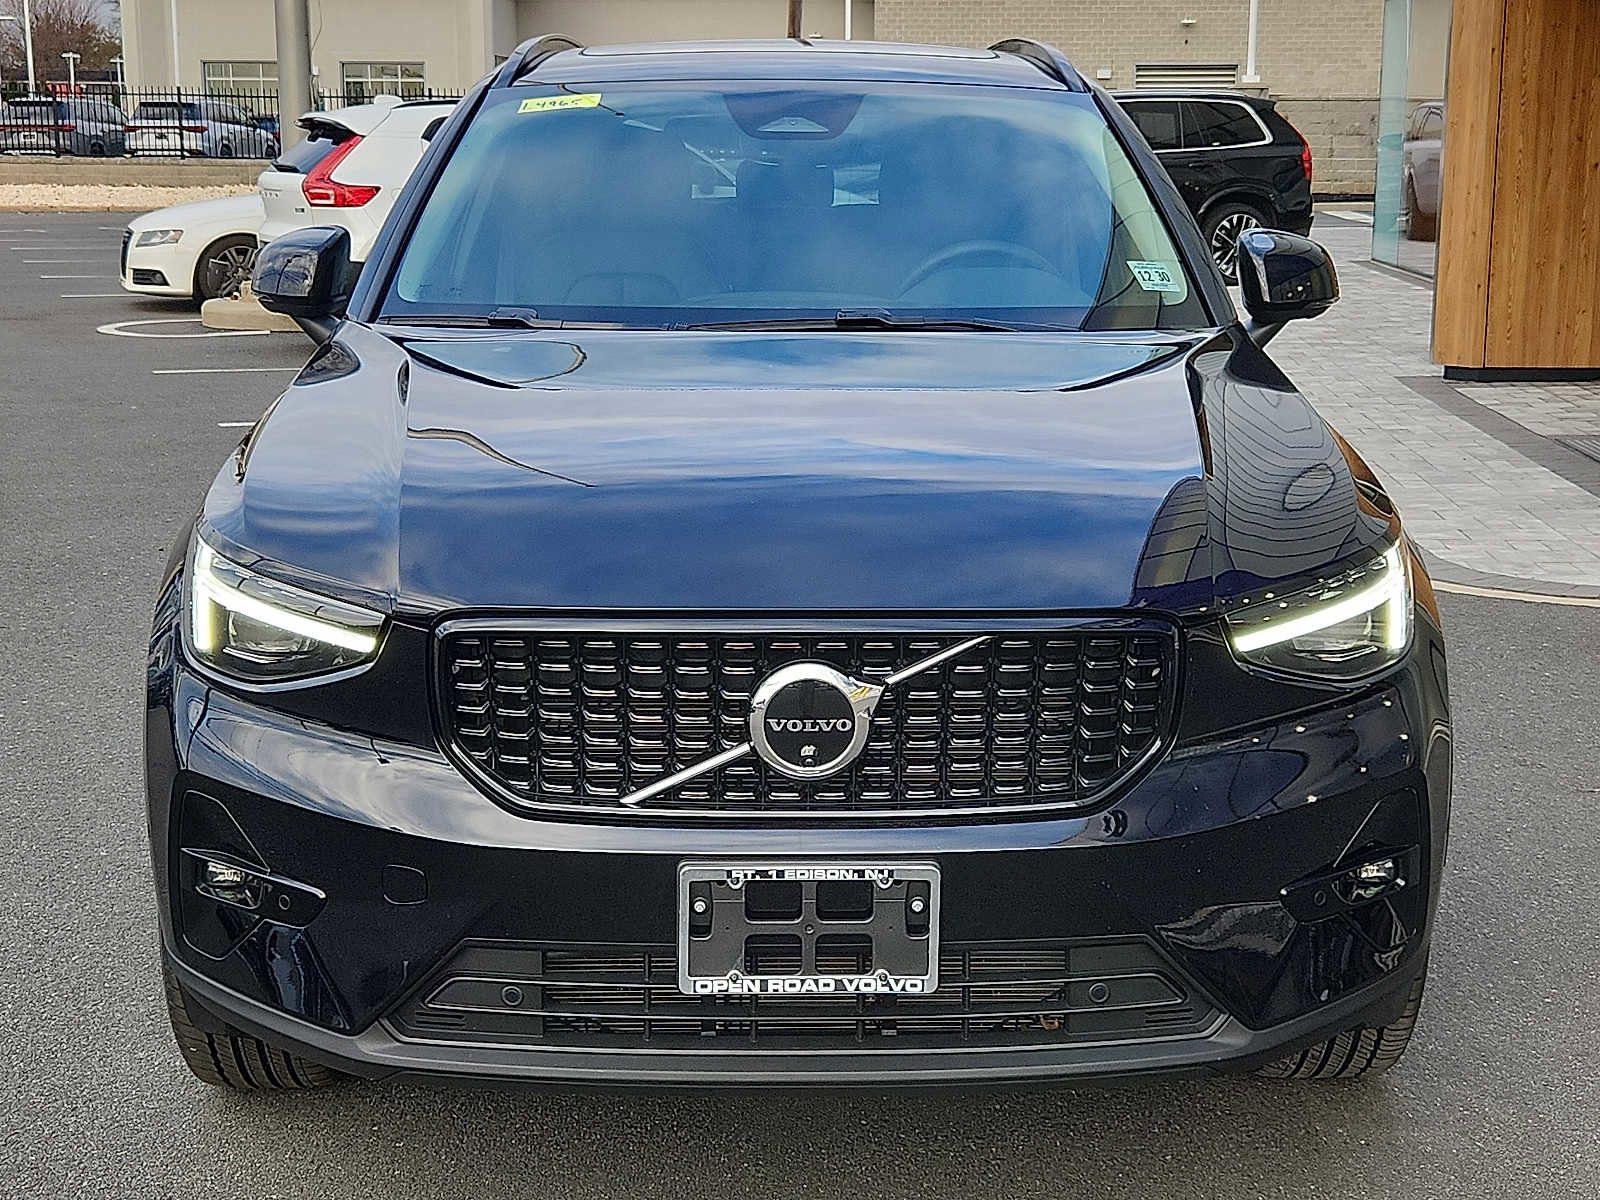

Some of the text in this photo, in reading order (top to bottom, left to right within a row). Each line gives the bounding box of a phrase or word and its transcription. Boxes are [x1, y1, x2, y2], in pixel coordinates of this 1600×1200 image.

[1137, 270, 1171, 282] 12 30
[766, 718, 853, 732] VOLVO
[768, 869, 778, 880] 1
[864, 869, 890, 881] NJ
[695, 978, 924, 993] OPEN ROAD VOLVO
